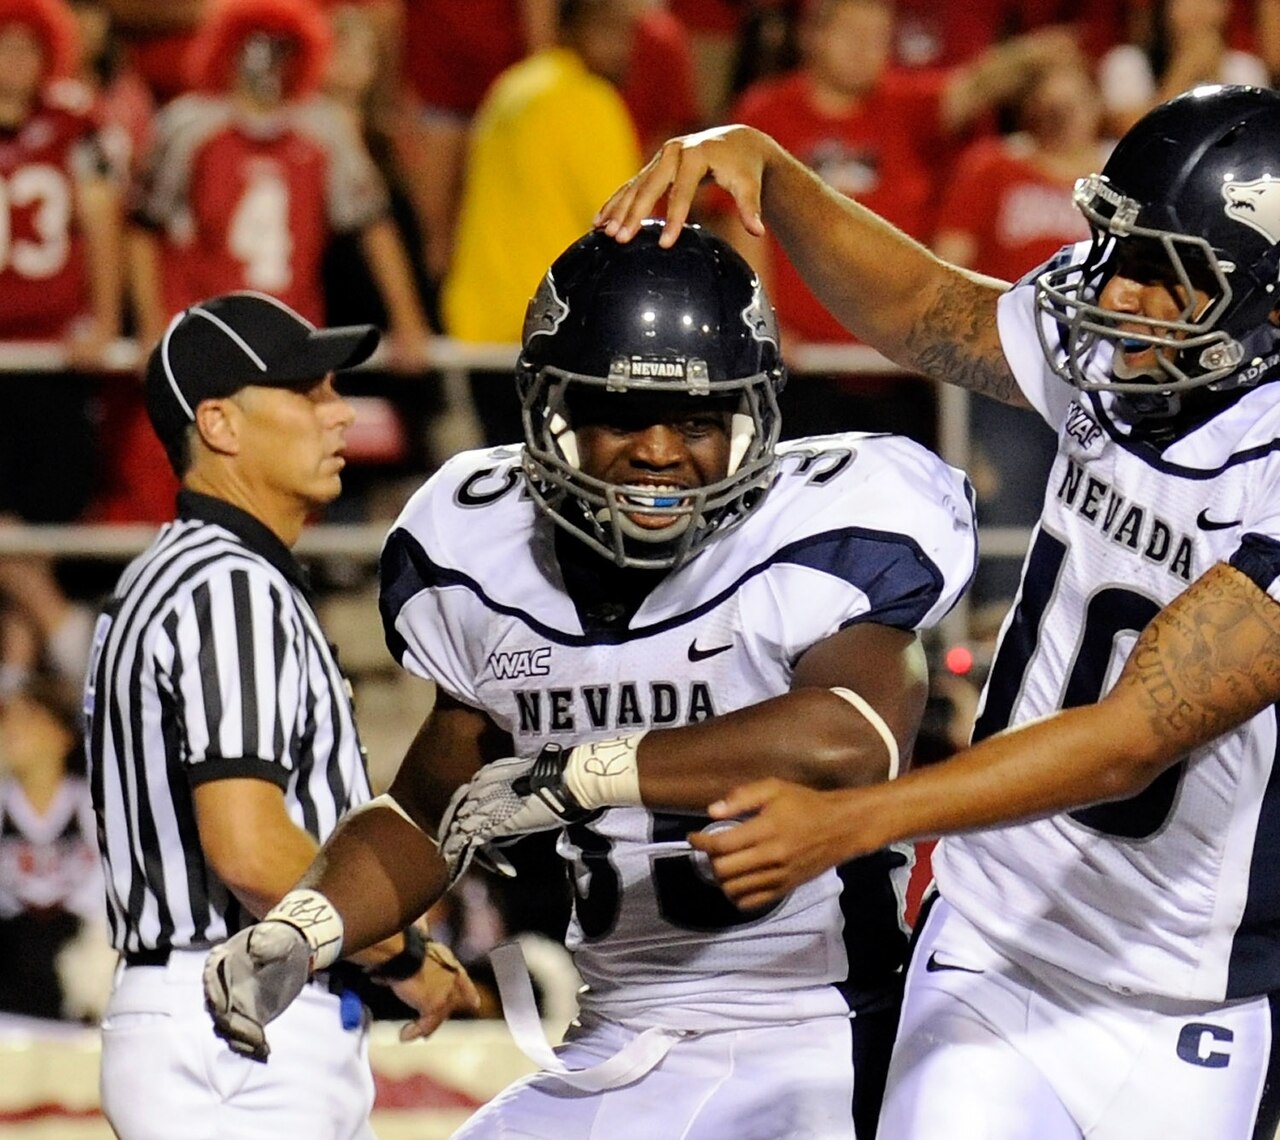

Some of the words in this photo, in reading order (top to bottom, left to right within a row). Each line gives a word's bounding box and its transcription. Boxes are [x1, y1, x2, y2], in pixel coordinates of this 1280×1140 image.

[0, 164, 70, 278] 3
[631, 361, 684, 378] NEVADA
[1057, 455, 1198, 586] NEVADA
[489, 646, 552, 680] WAC
[513, 680, 717, 737] NEVADA
[1175, 1021, 1235, 1070] C
